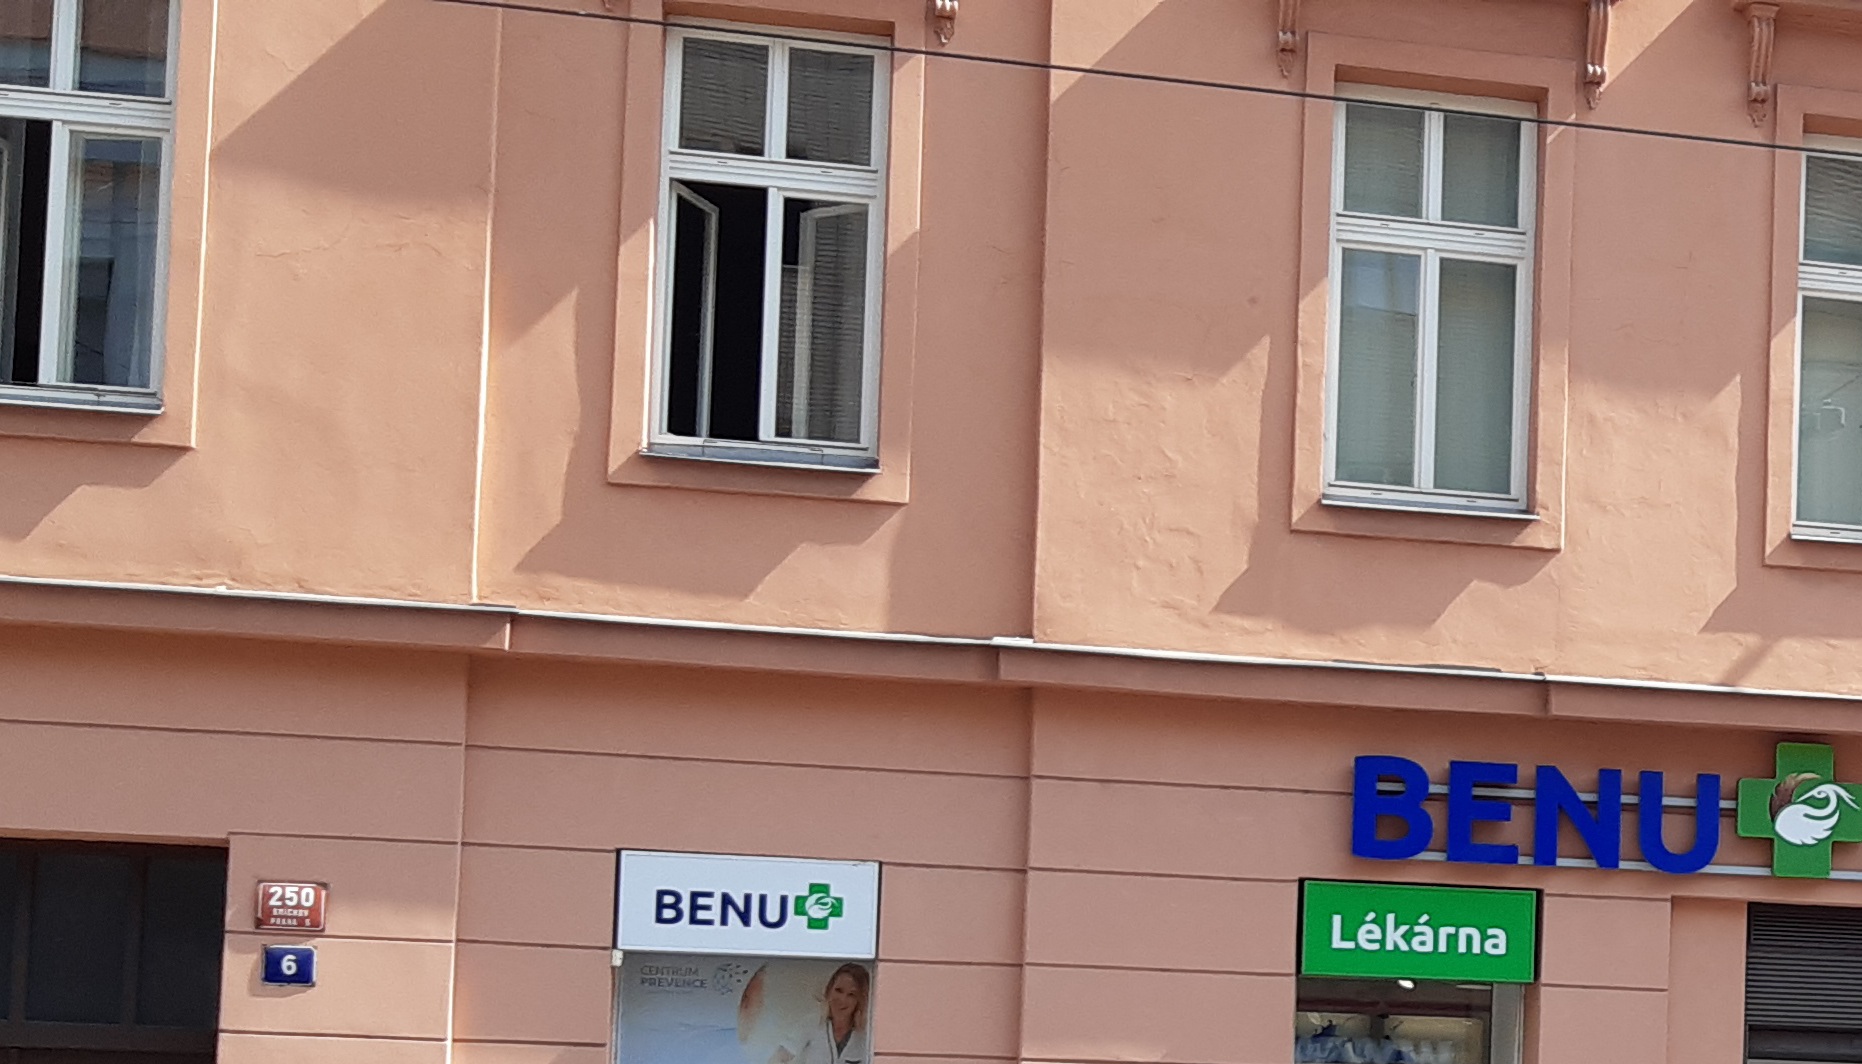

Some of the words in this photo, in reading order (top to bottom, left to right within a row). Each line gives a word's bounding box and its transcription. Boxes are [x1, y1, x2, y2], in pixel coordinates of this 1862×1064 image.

[1351, 755, 1720, 875] BENU
[269, 886, 315, 907] 250
[655, 889, 789, 929] BENU
[1331, 912, 1508, 957] Lékárna
[281, 954, 297, 976] 6
[639, 977, 708, 989] PREVENCE
